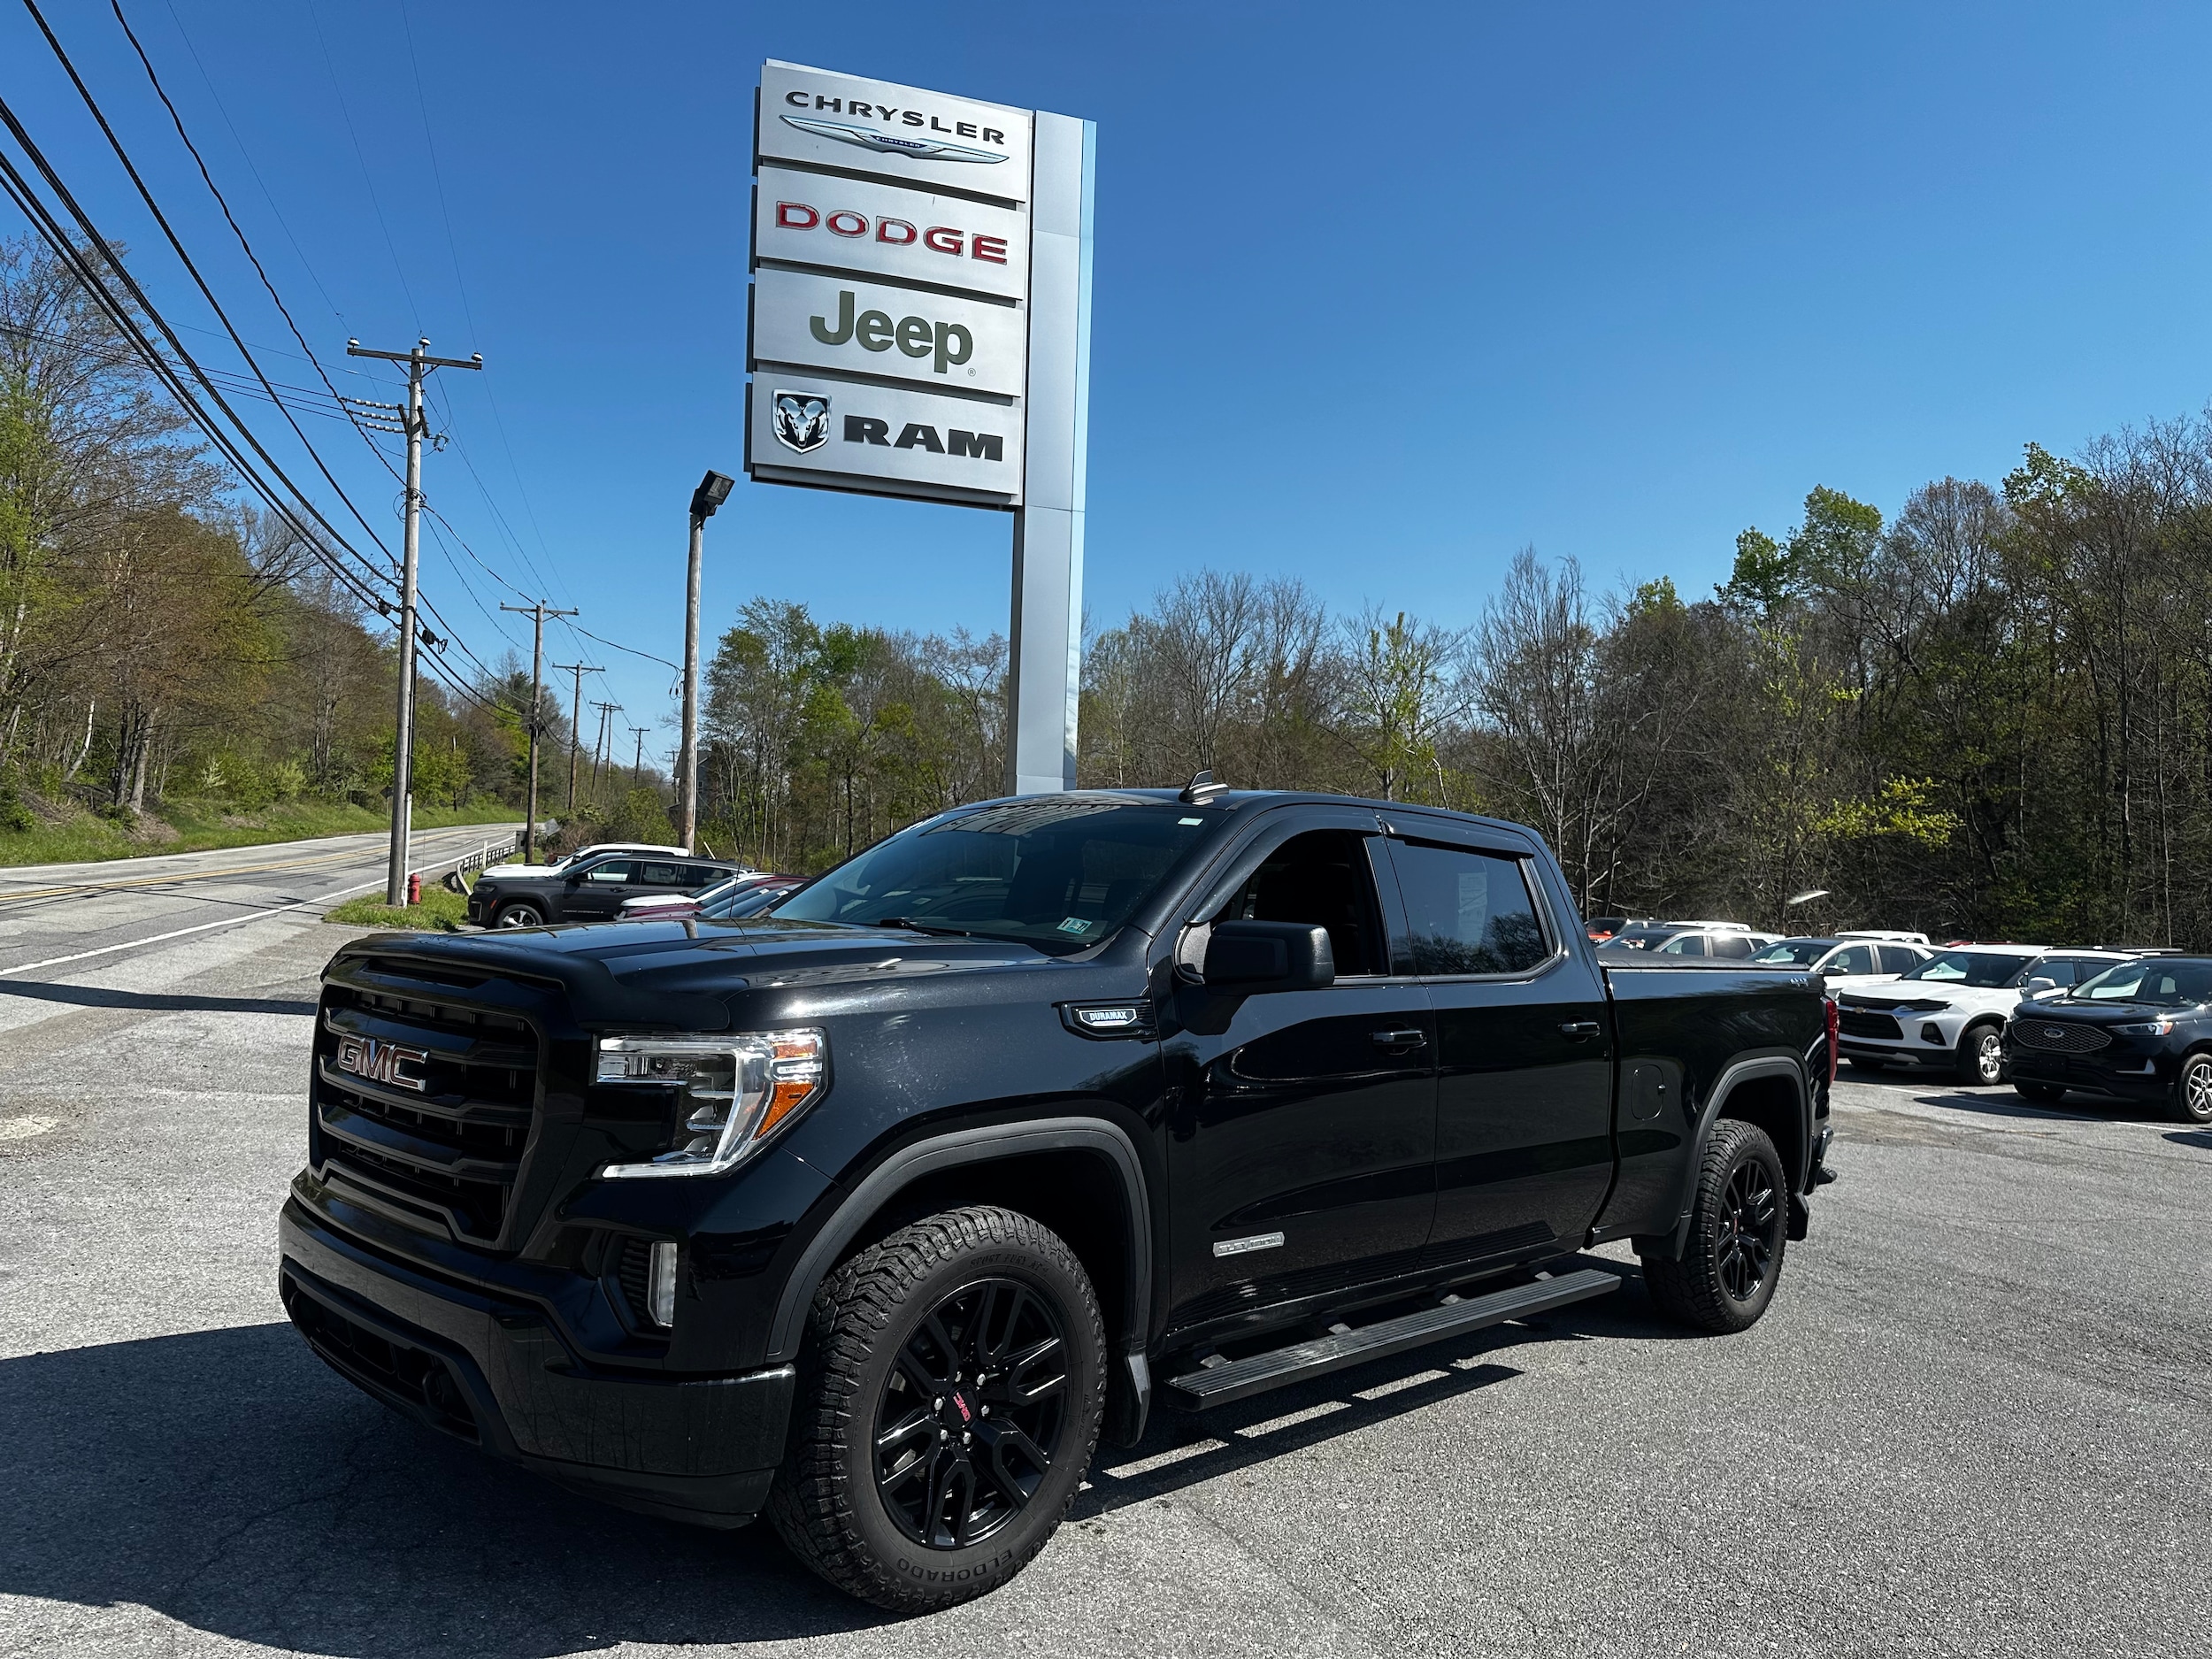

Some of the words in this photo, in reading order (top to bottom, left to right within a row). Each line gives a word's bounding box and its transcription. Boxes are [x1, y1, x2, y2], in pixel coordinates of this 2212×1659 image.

[785, 91, 1005, 145] CHRYSLER
[776, 200, 1008, 265] DODGE
[810, 290, 973, 373] Jeep
[843, 414, 1003, 462] RAM
[1088, 1010, 1128, 1021] DURAMAX
[338, 1033, 429, 1092] GMC
[896, 1548, 1013, 1582] ELDORADO
